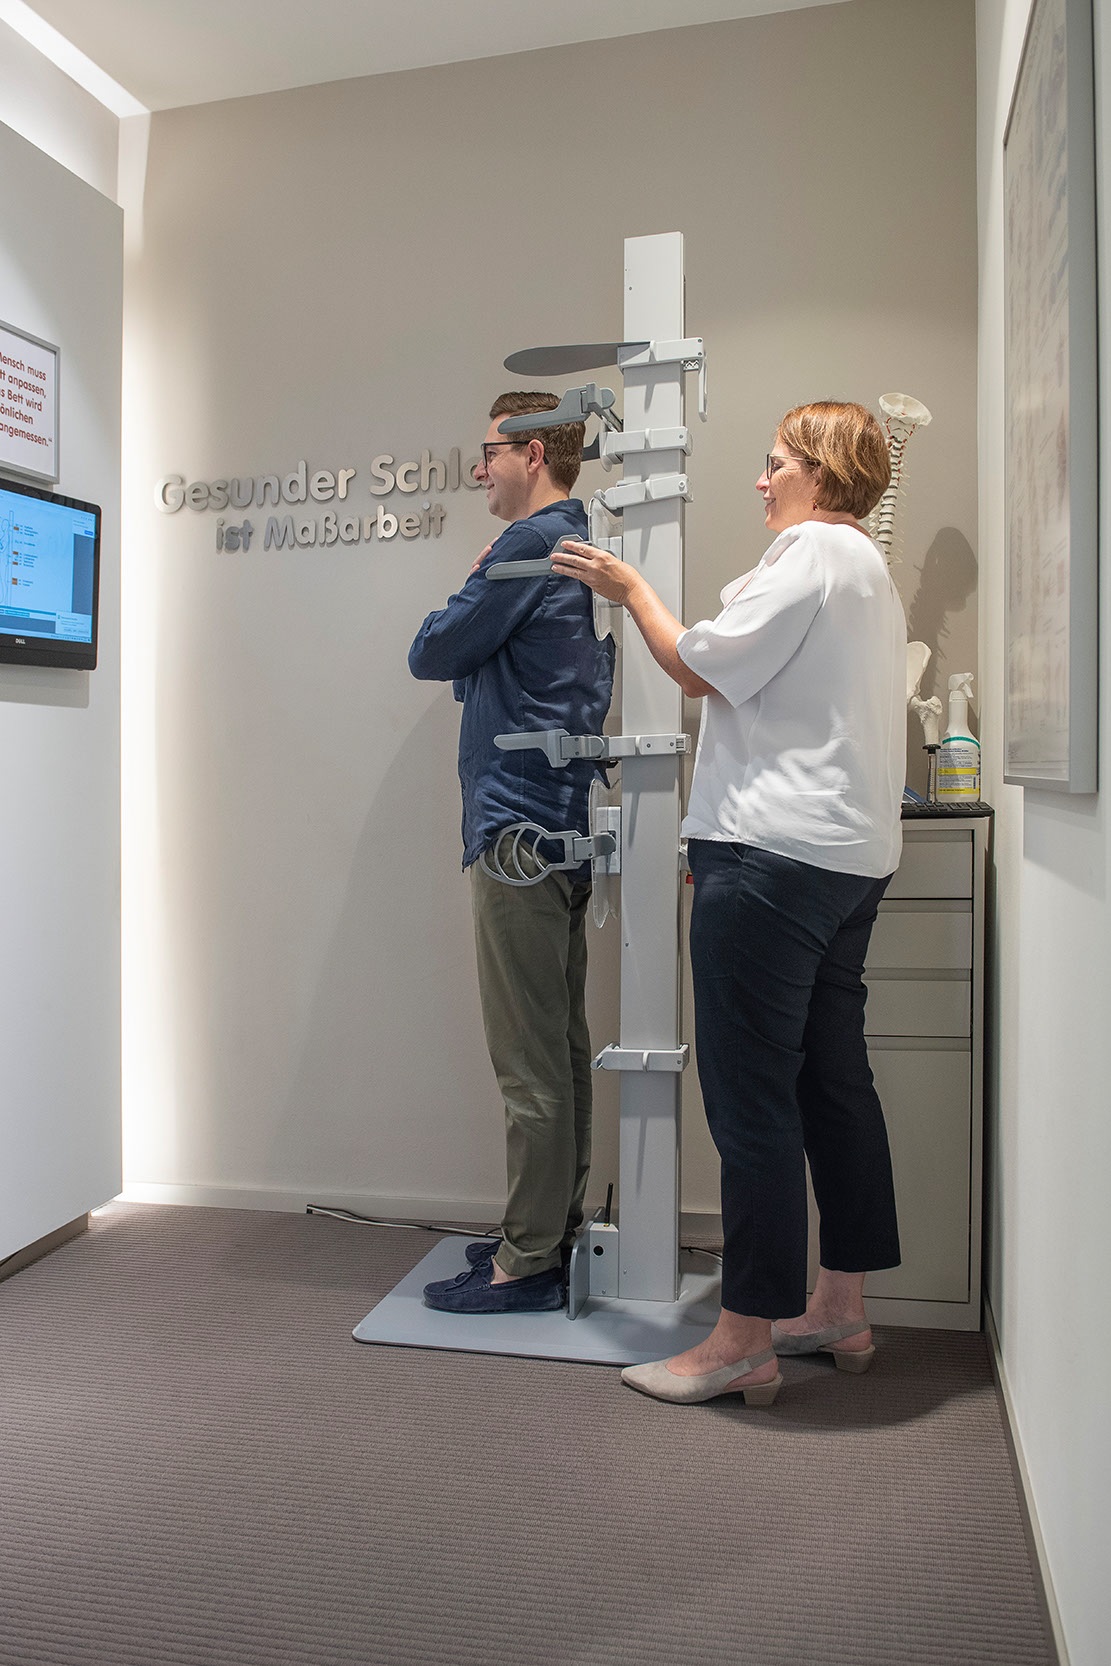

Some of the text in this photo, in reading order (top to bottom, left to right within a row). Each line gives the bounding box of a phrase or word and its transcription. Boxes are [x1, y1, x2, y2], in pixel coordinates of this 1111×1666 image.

[27, 366, 47, 381] muss
[8, 375, 46, 398] anpassen,
[8, 389, 24, 404] Bett
[25, 398, 42, 412] wird
[153, 459, 356, 515] Gesunder
[216, 502, 446, 551] ist Maßarbeit
